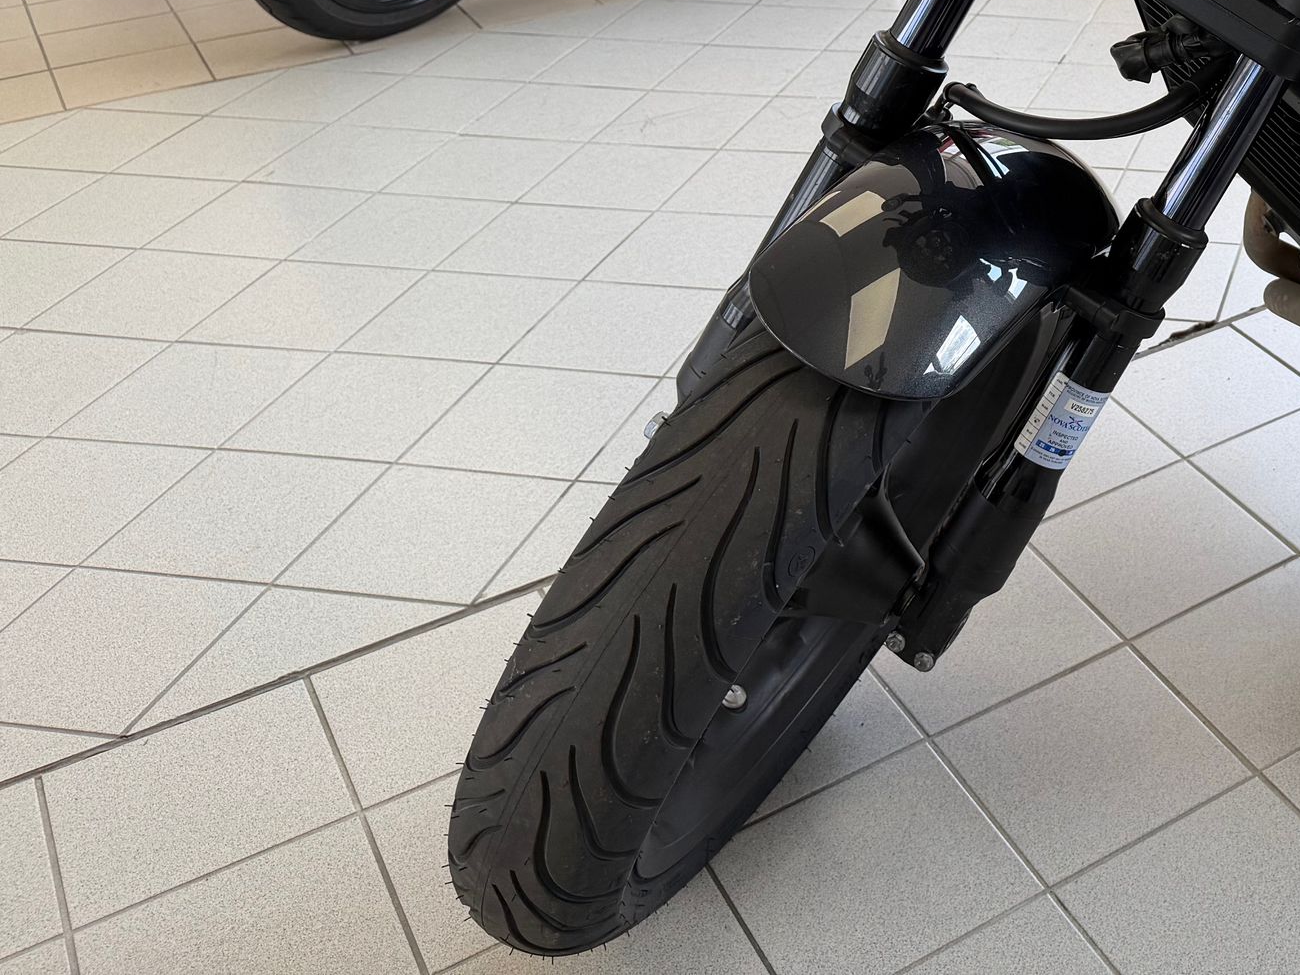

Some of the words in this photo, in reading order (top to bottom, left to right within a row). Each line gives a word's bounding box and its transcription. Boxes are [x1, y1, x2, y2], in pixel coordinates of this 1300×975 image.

[1048, 415, 1068, 429] NOVA
[1053, 430, 1079, 441] INSPECTED
[1047, 439, 1074, 449] APPROVED
